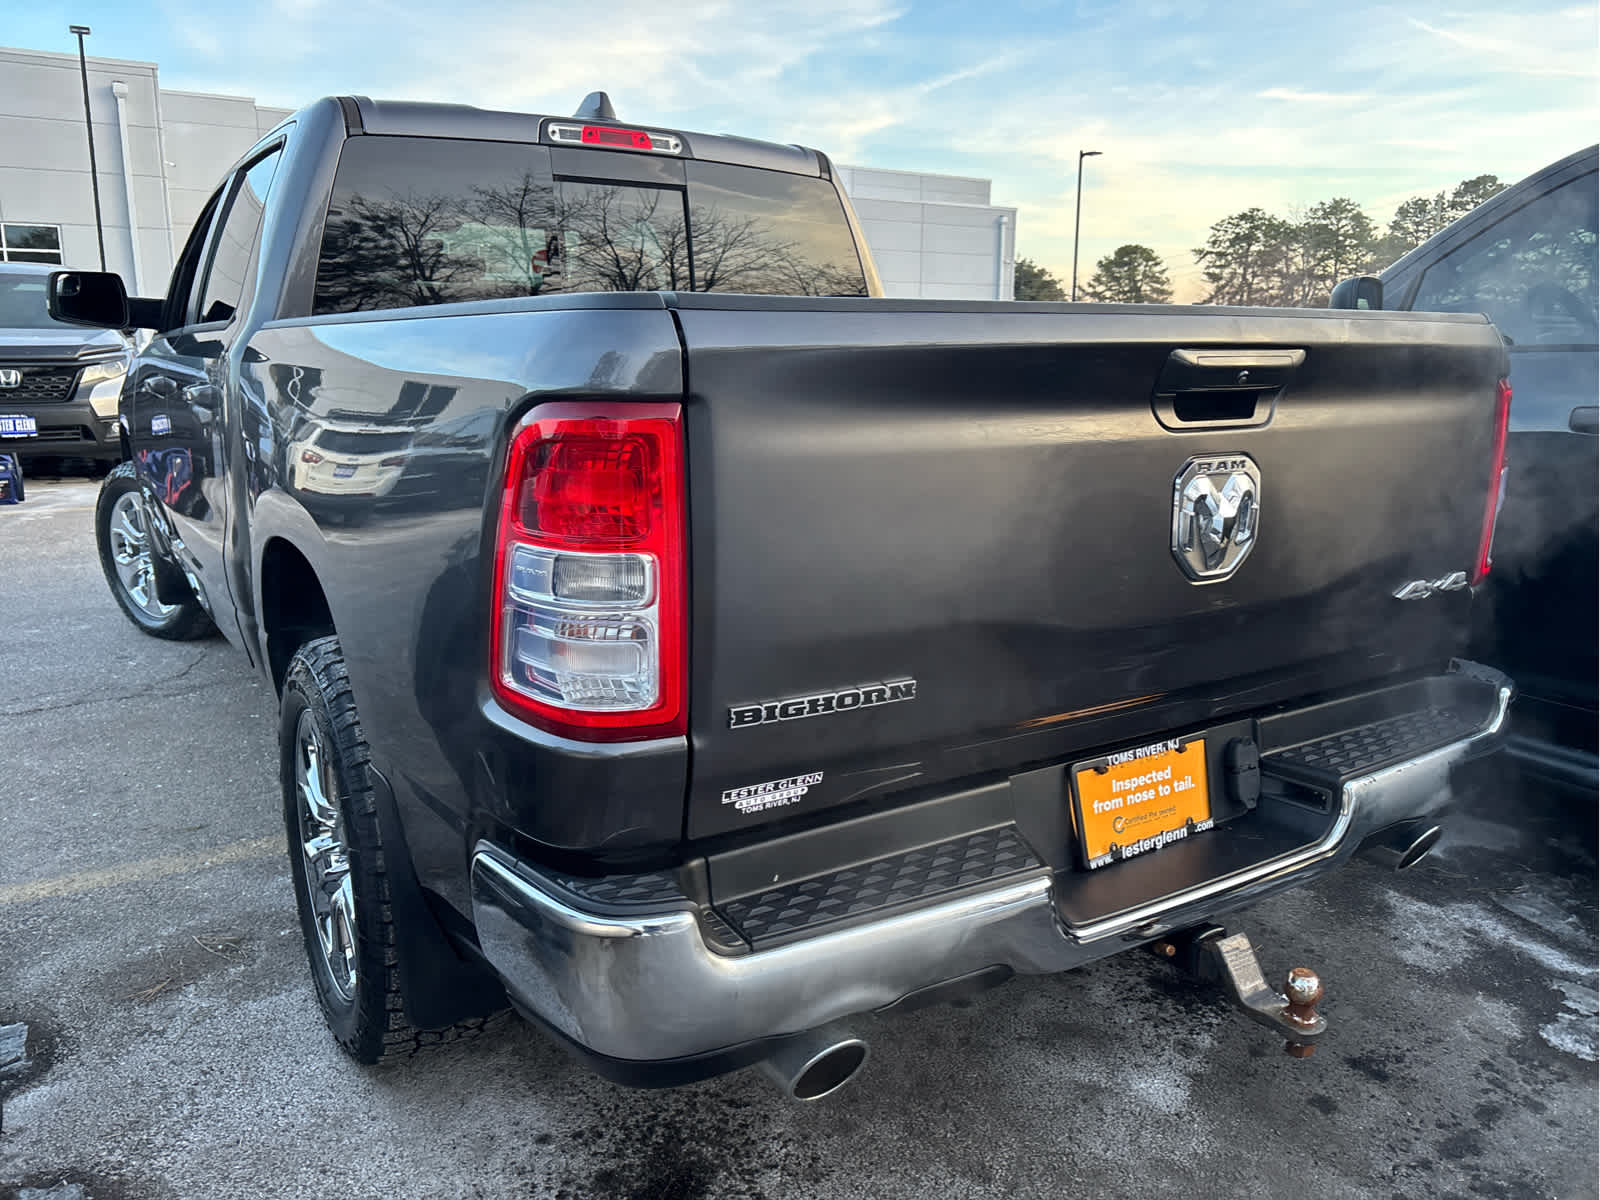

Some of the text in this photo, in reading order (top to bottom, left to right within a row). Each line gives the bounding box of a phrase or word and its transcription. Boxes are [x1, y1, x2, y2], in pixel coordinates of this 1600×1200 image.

[1197, 459, 1246, 472] RAM
[728, 678, 917, 729] BIGHORN
[1107, 750, 1133, 766] TOMS
[1167, 739, 1179, 750] NJ
[722, 774, 822, 801] LESTER GLENN
[1111, 765, 1172, 793] Inspected
[741, 804, 764, 814] TOMS
[791, 795, 801, 803] NJ
[1092, 775, 1196, 815] from nose to tail.
[1089, 853, 1114, 870] www.
[1121, 828, 1188, 859] lesterglenn
[1194, 818, 1215, 833] .com
